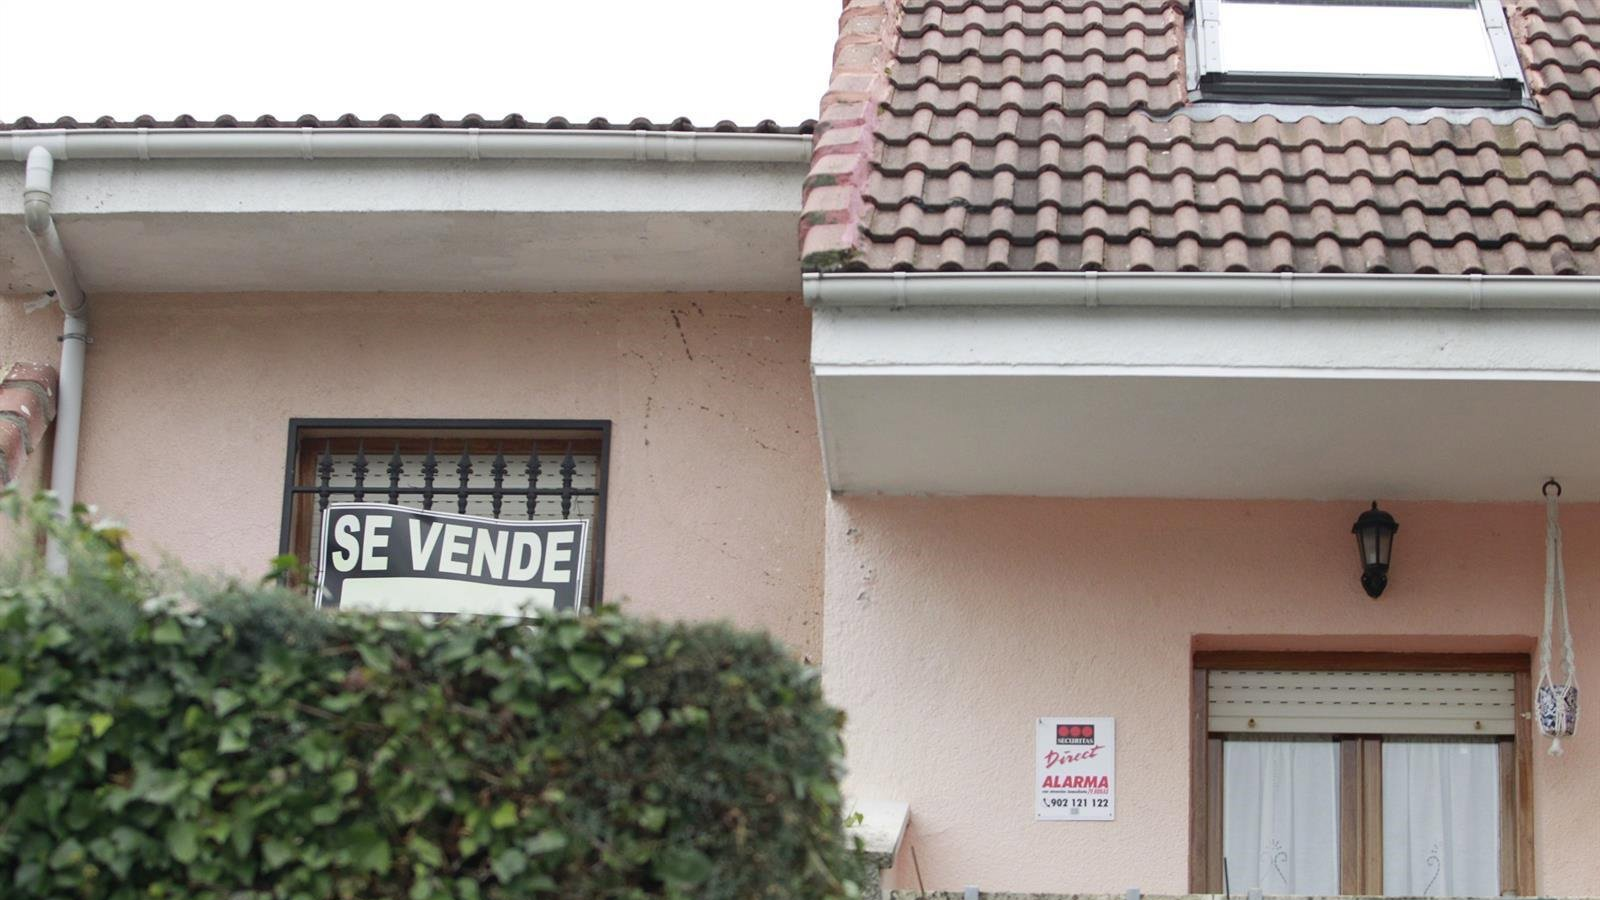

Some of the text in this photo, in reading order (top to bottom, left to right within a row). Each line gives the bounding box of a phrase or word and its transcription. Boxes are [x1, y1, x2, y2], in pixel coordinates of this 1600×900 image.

[331, 514, 575, 583] SE VENDE
[1044, 745, 1106, 769] Direct
[1042, 775, 1109, 788] ALARMA
[1051, 798, 1108, 807] 902 121 122
